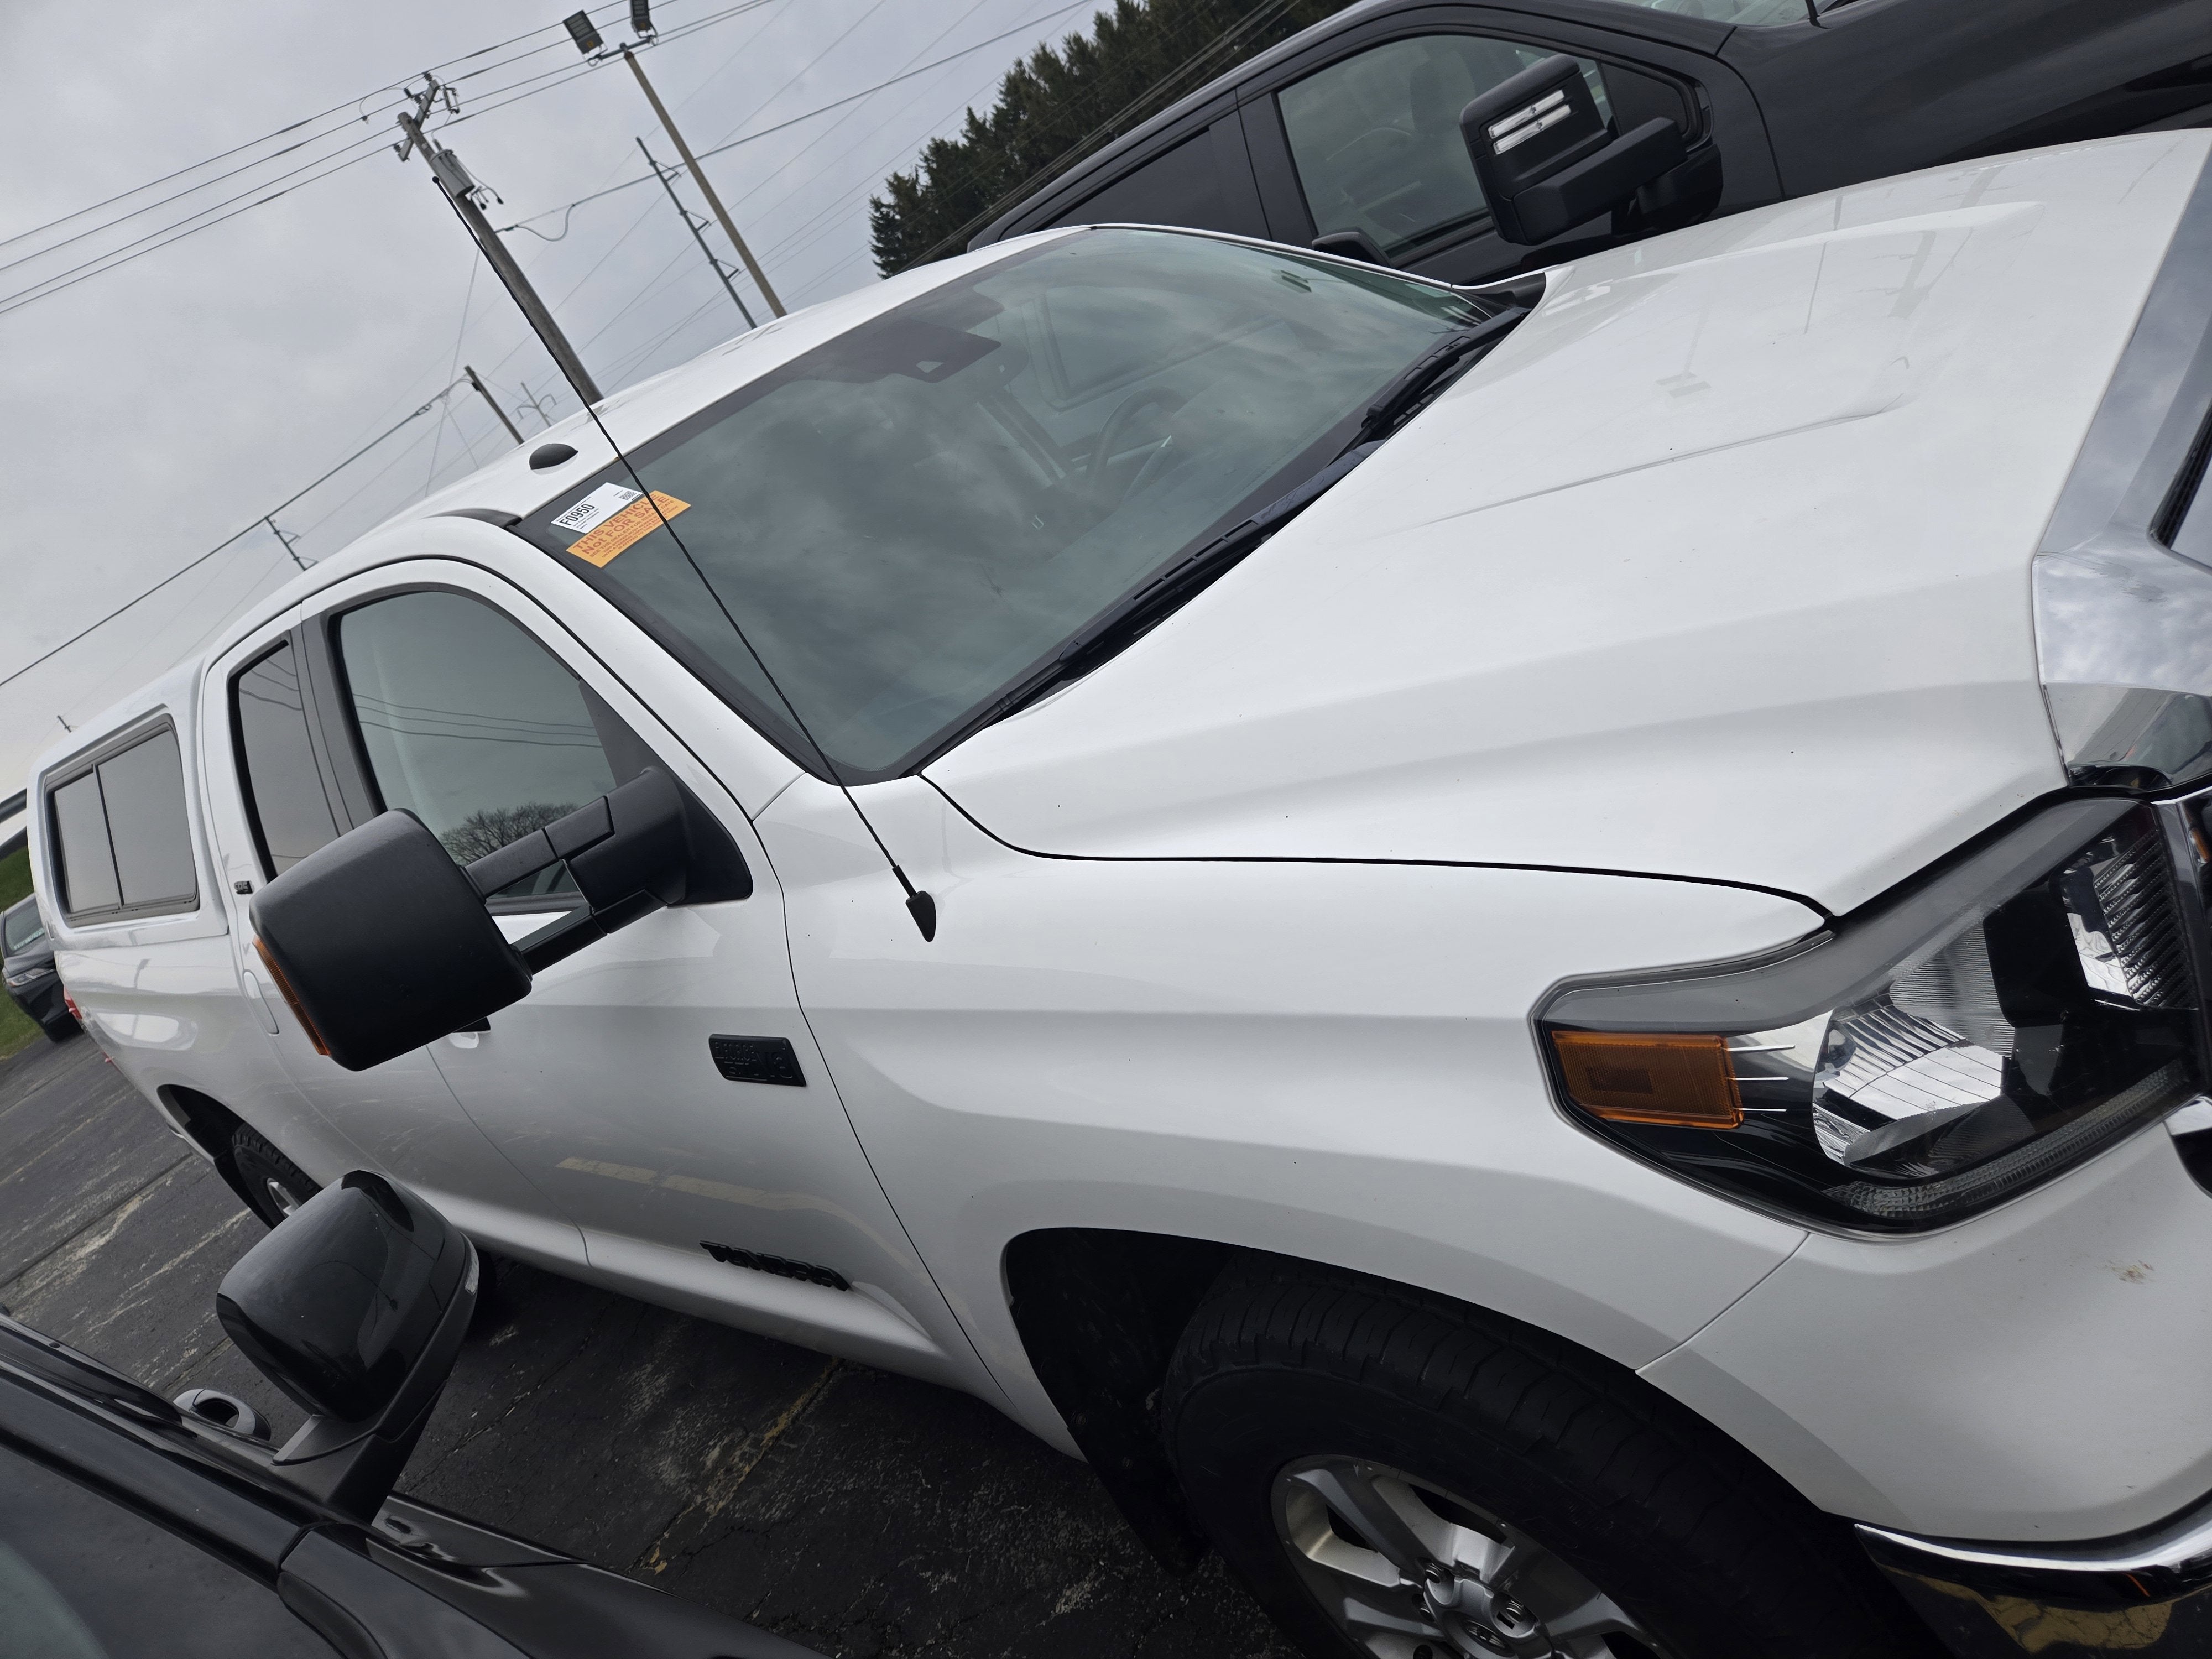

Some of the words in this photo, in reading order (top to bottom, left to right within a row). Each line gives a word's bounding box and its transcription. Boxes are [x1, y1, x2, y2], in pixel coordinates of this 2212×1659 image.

[559, 504, 595, 525] F0950
[573, 529, 604, 549] THIS
[604, 494, 659, 528] VEHICLE
[609, 528, 632, 541] DEALER
[659, 499, 675, 509] DATE
[582, 538, 606, 553] Not
[606, 519, 634, 536] FOR
